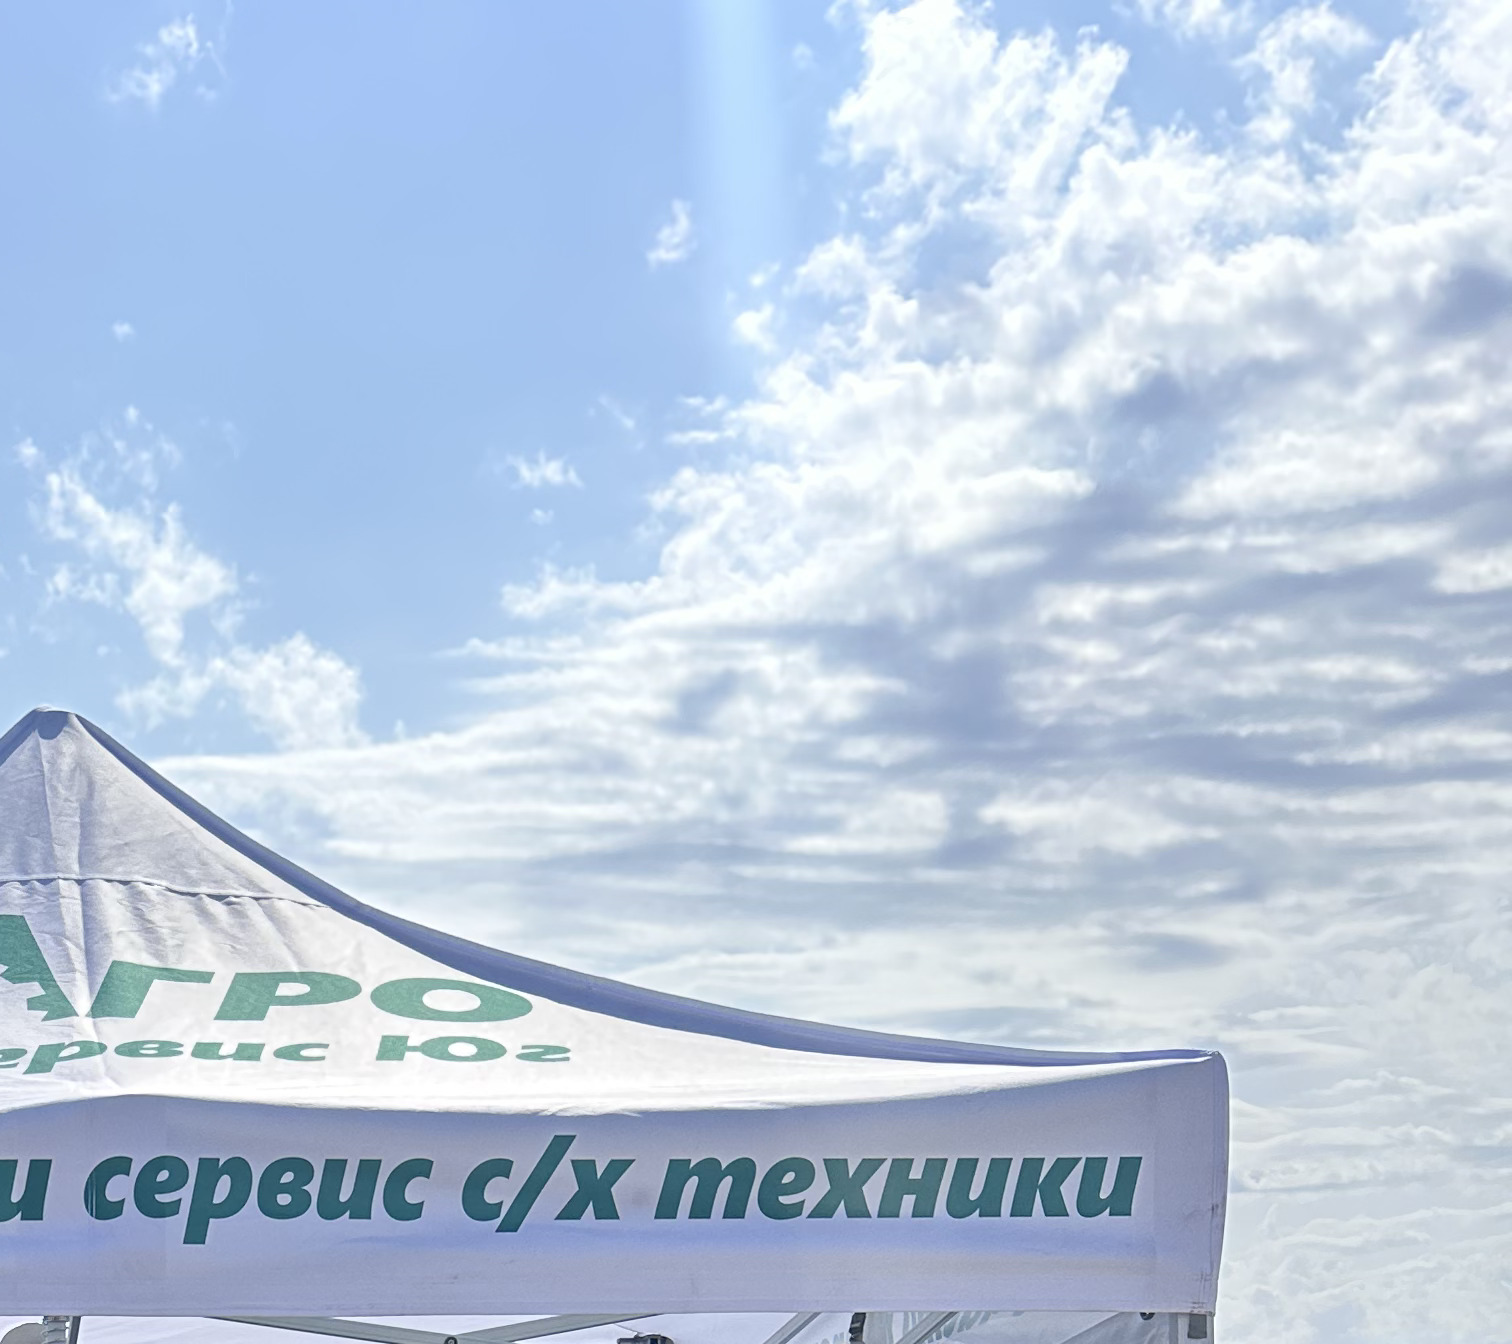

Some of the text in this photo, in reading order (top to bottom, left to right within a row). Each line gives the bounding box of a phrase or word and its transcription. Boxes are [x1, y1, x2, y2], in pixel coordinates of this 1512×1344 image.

[376, 1035, 571, 1064] Юг
[84, 1155, 437, 1245] сервис
[461, 1134, 635, 1233] с/х
[654, 1156, 1143, 1221] техники
